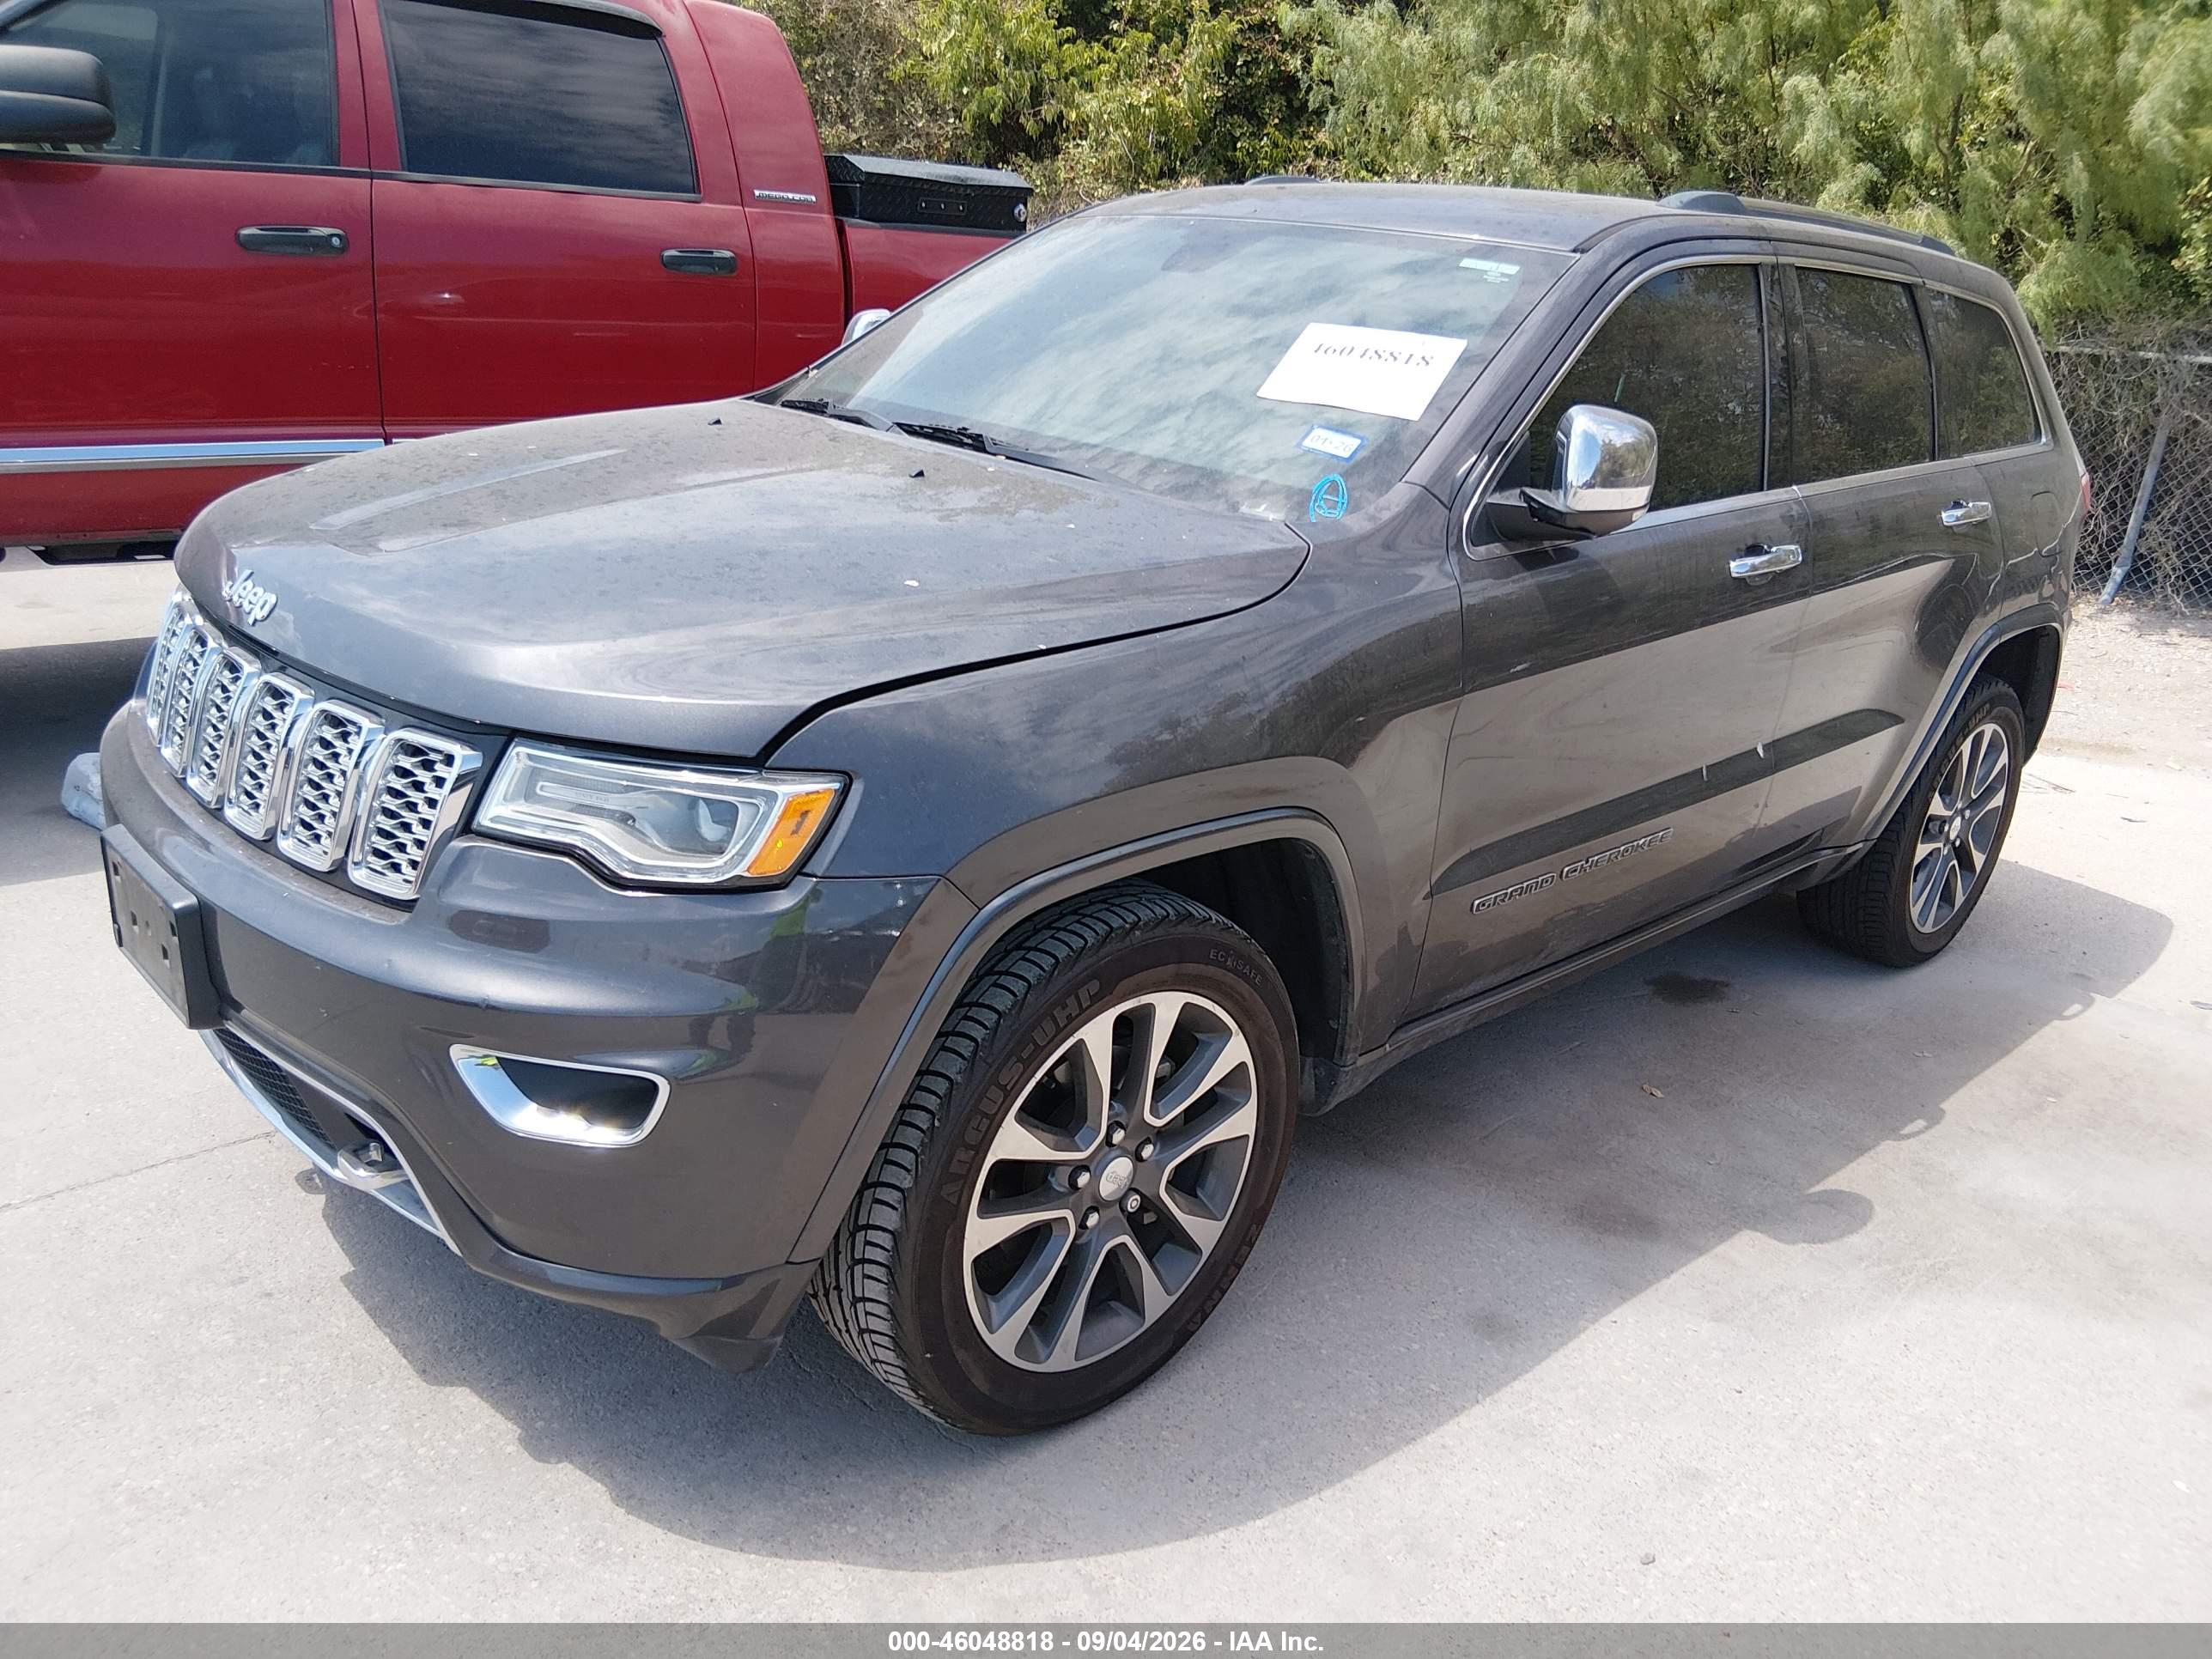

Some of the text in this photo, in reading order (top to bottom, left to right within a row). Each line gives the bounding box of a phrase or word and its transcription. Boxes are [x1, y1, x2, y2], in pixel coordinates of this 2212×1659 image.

[222, 569, 279, 627] Jeep
[1471, 827, 1674, 914] GRAND CHEROKEE
[941, 978, 1101, 1206] ARGUS-UHP
